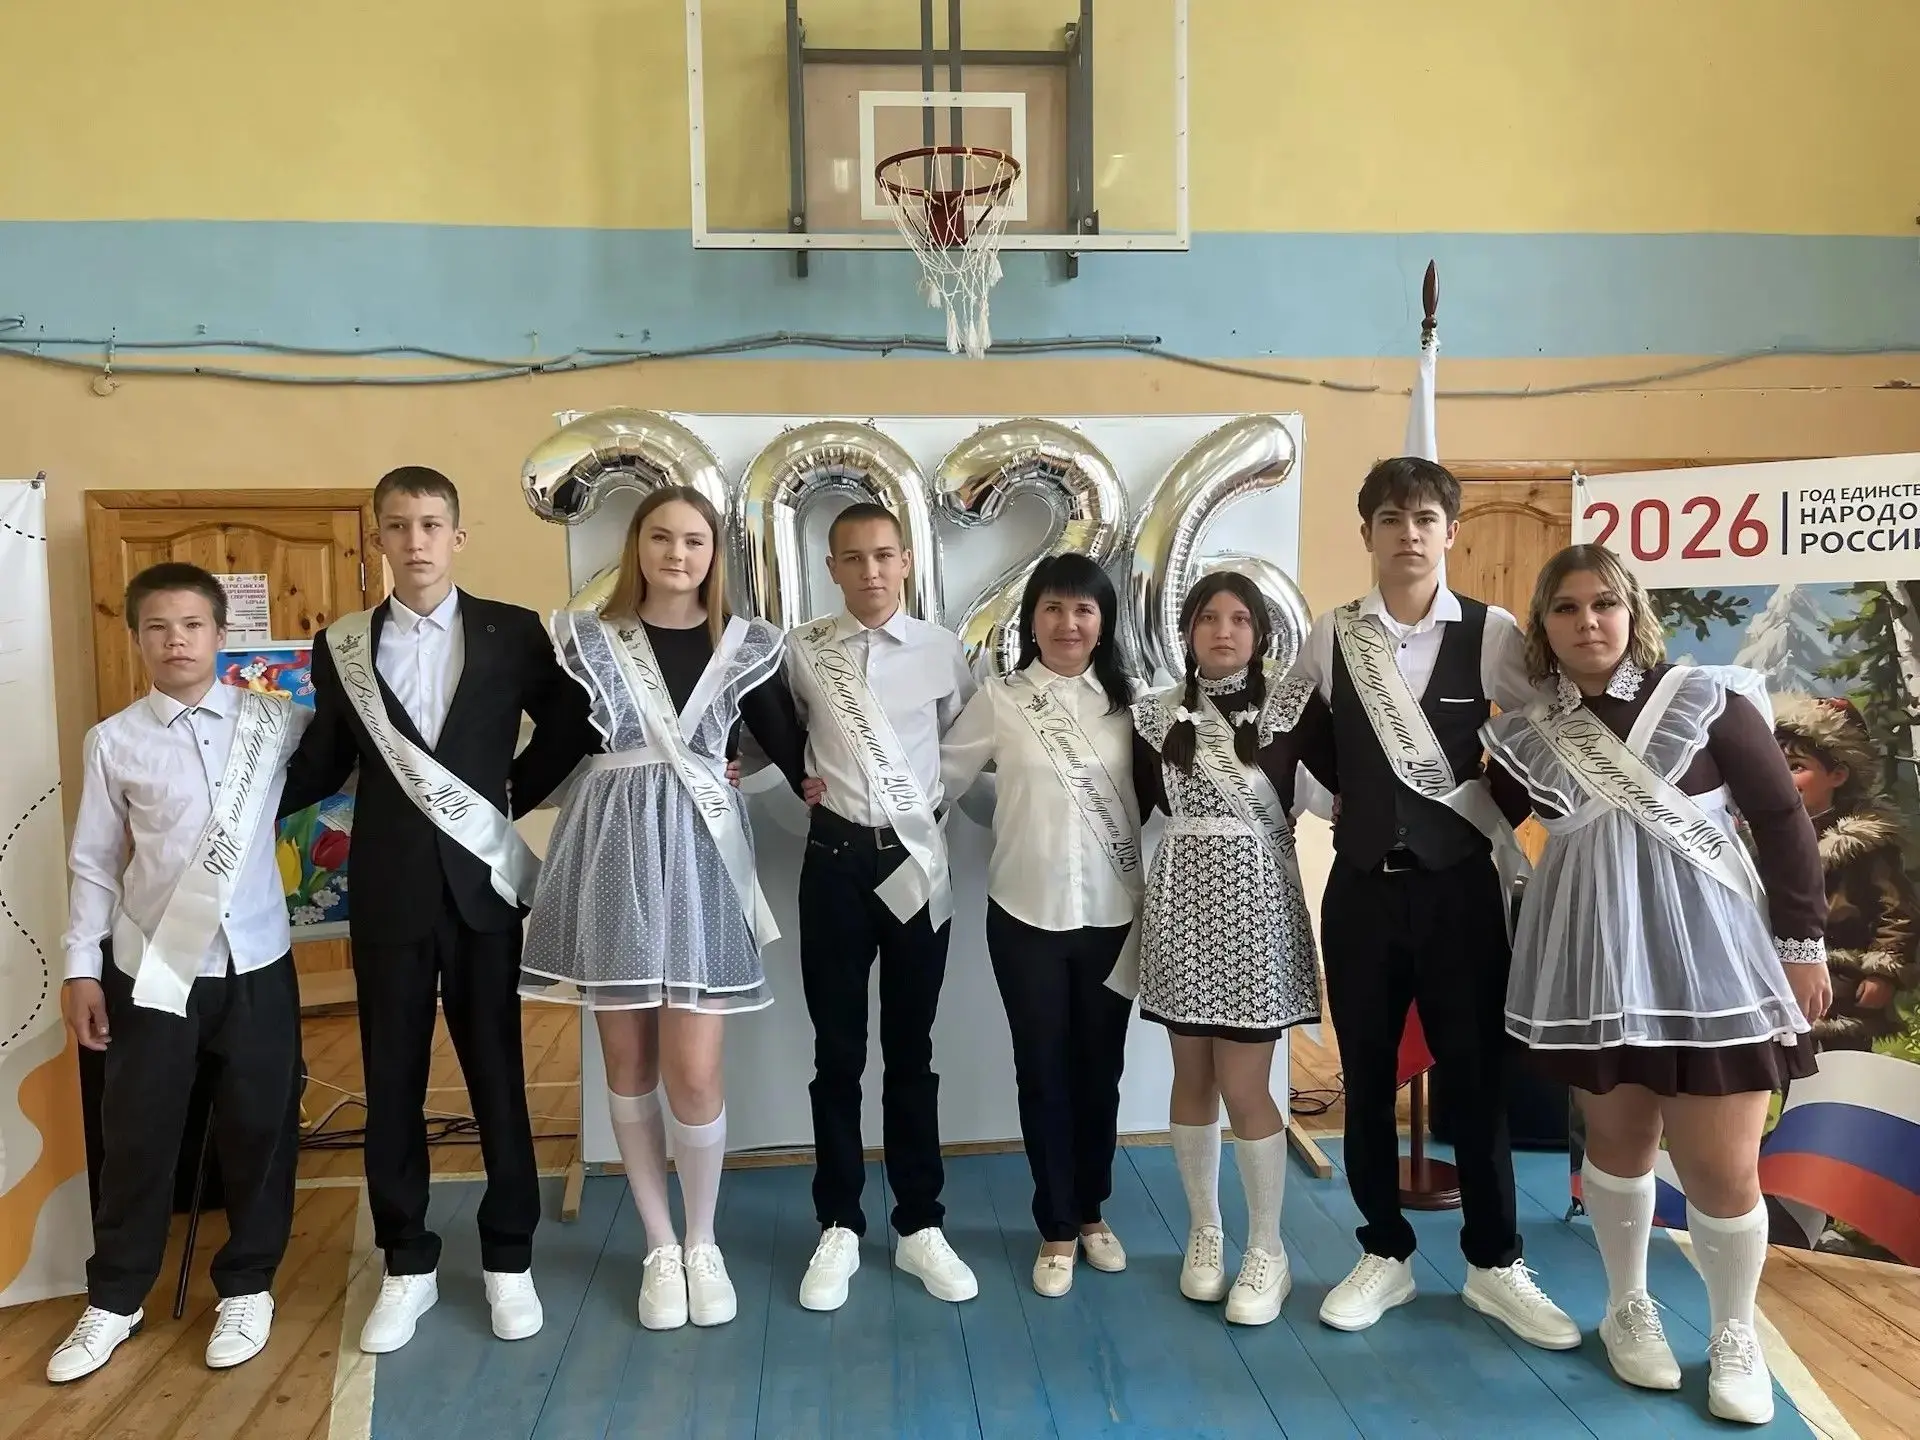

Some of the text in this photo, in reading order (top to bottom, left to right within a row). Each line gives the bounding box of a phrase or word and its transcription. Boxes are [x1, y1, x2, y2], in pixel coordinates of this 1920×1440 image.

[1583, 493, 1769, 562] 2026
[1800, 488, 1836, 504] ГОД
[1800, 502, 1918, 526] НАРОДО
[521, 406, 1312, 681] 2026
[816, 649, 922, 812] Выпускник 2026
[1348, 619, 1449, 797] Выпускник 2026
[203, 693, 284, 883] Выпускник 2026
[424, 783, 479, 821] 2026
[692, 782, 731, 819] 2026
[1195, 719, 1274, 826] Выпускница
[1556, 719, 1731, 860] Выпускница 2026
[1111, 838, 1140, 873] 2026
